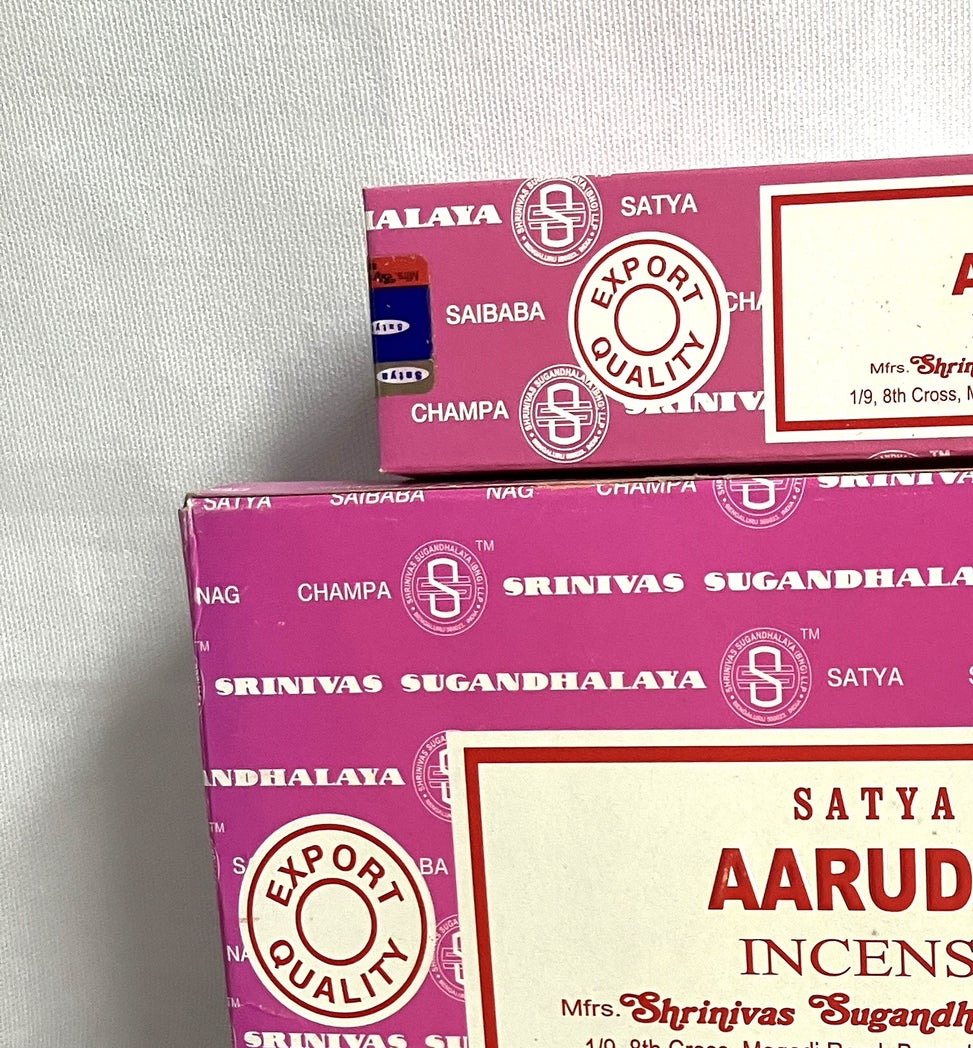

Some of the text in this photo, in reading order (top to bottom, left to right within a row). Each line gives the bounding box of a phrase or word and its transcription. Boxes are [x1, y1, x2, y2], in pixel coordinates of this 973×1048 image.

[620, 193, 698, 217] SATYA
[591, 255, 704, 309] EXPORT
[445, 301, 546, 325] SAIBABA
[590, 330, 705, 389] QUALITY
[868, 360, 910, 378] Mfrs.
[411, 400, 510, 423] CHAMPA
[850, 388, 877, 407] 1/9,
[882, 387, 906, 404] 8th
[911, 386, 961, 404] Cross,
[475, 540, 495, 552] TM
[502, 573, 685, 596] SRINIVAS
[194, 581, 392, 606] NAG CHAMPA
[800, 628, 820, 640] TM
[827, 667, 904, 688] SATYA
[214, 670, 707, 696] SRINIVAS SUGANDHALAYA
[793, 786, 956, 821] SATYA
[265, 844, 404, 906] EXPORT
[269, 937, 408, 1004] QUALITY
[561, 1000, 620, 1019] Mfrs.
[620, 992, 796, 1033] Shrinivas
